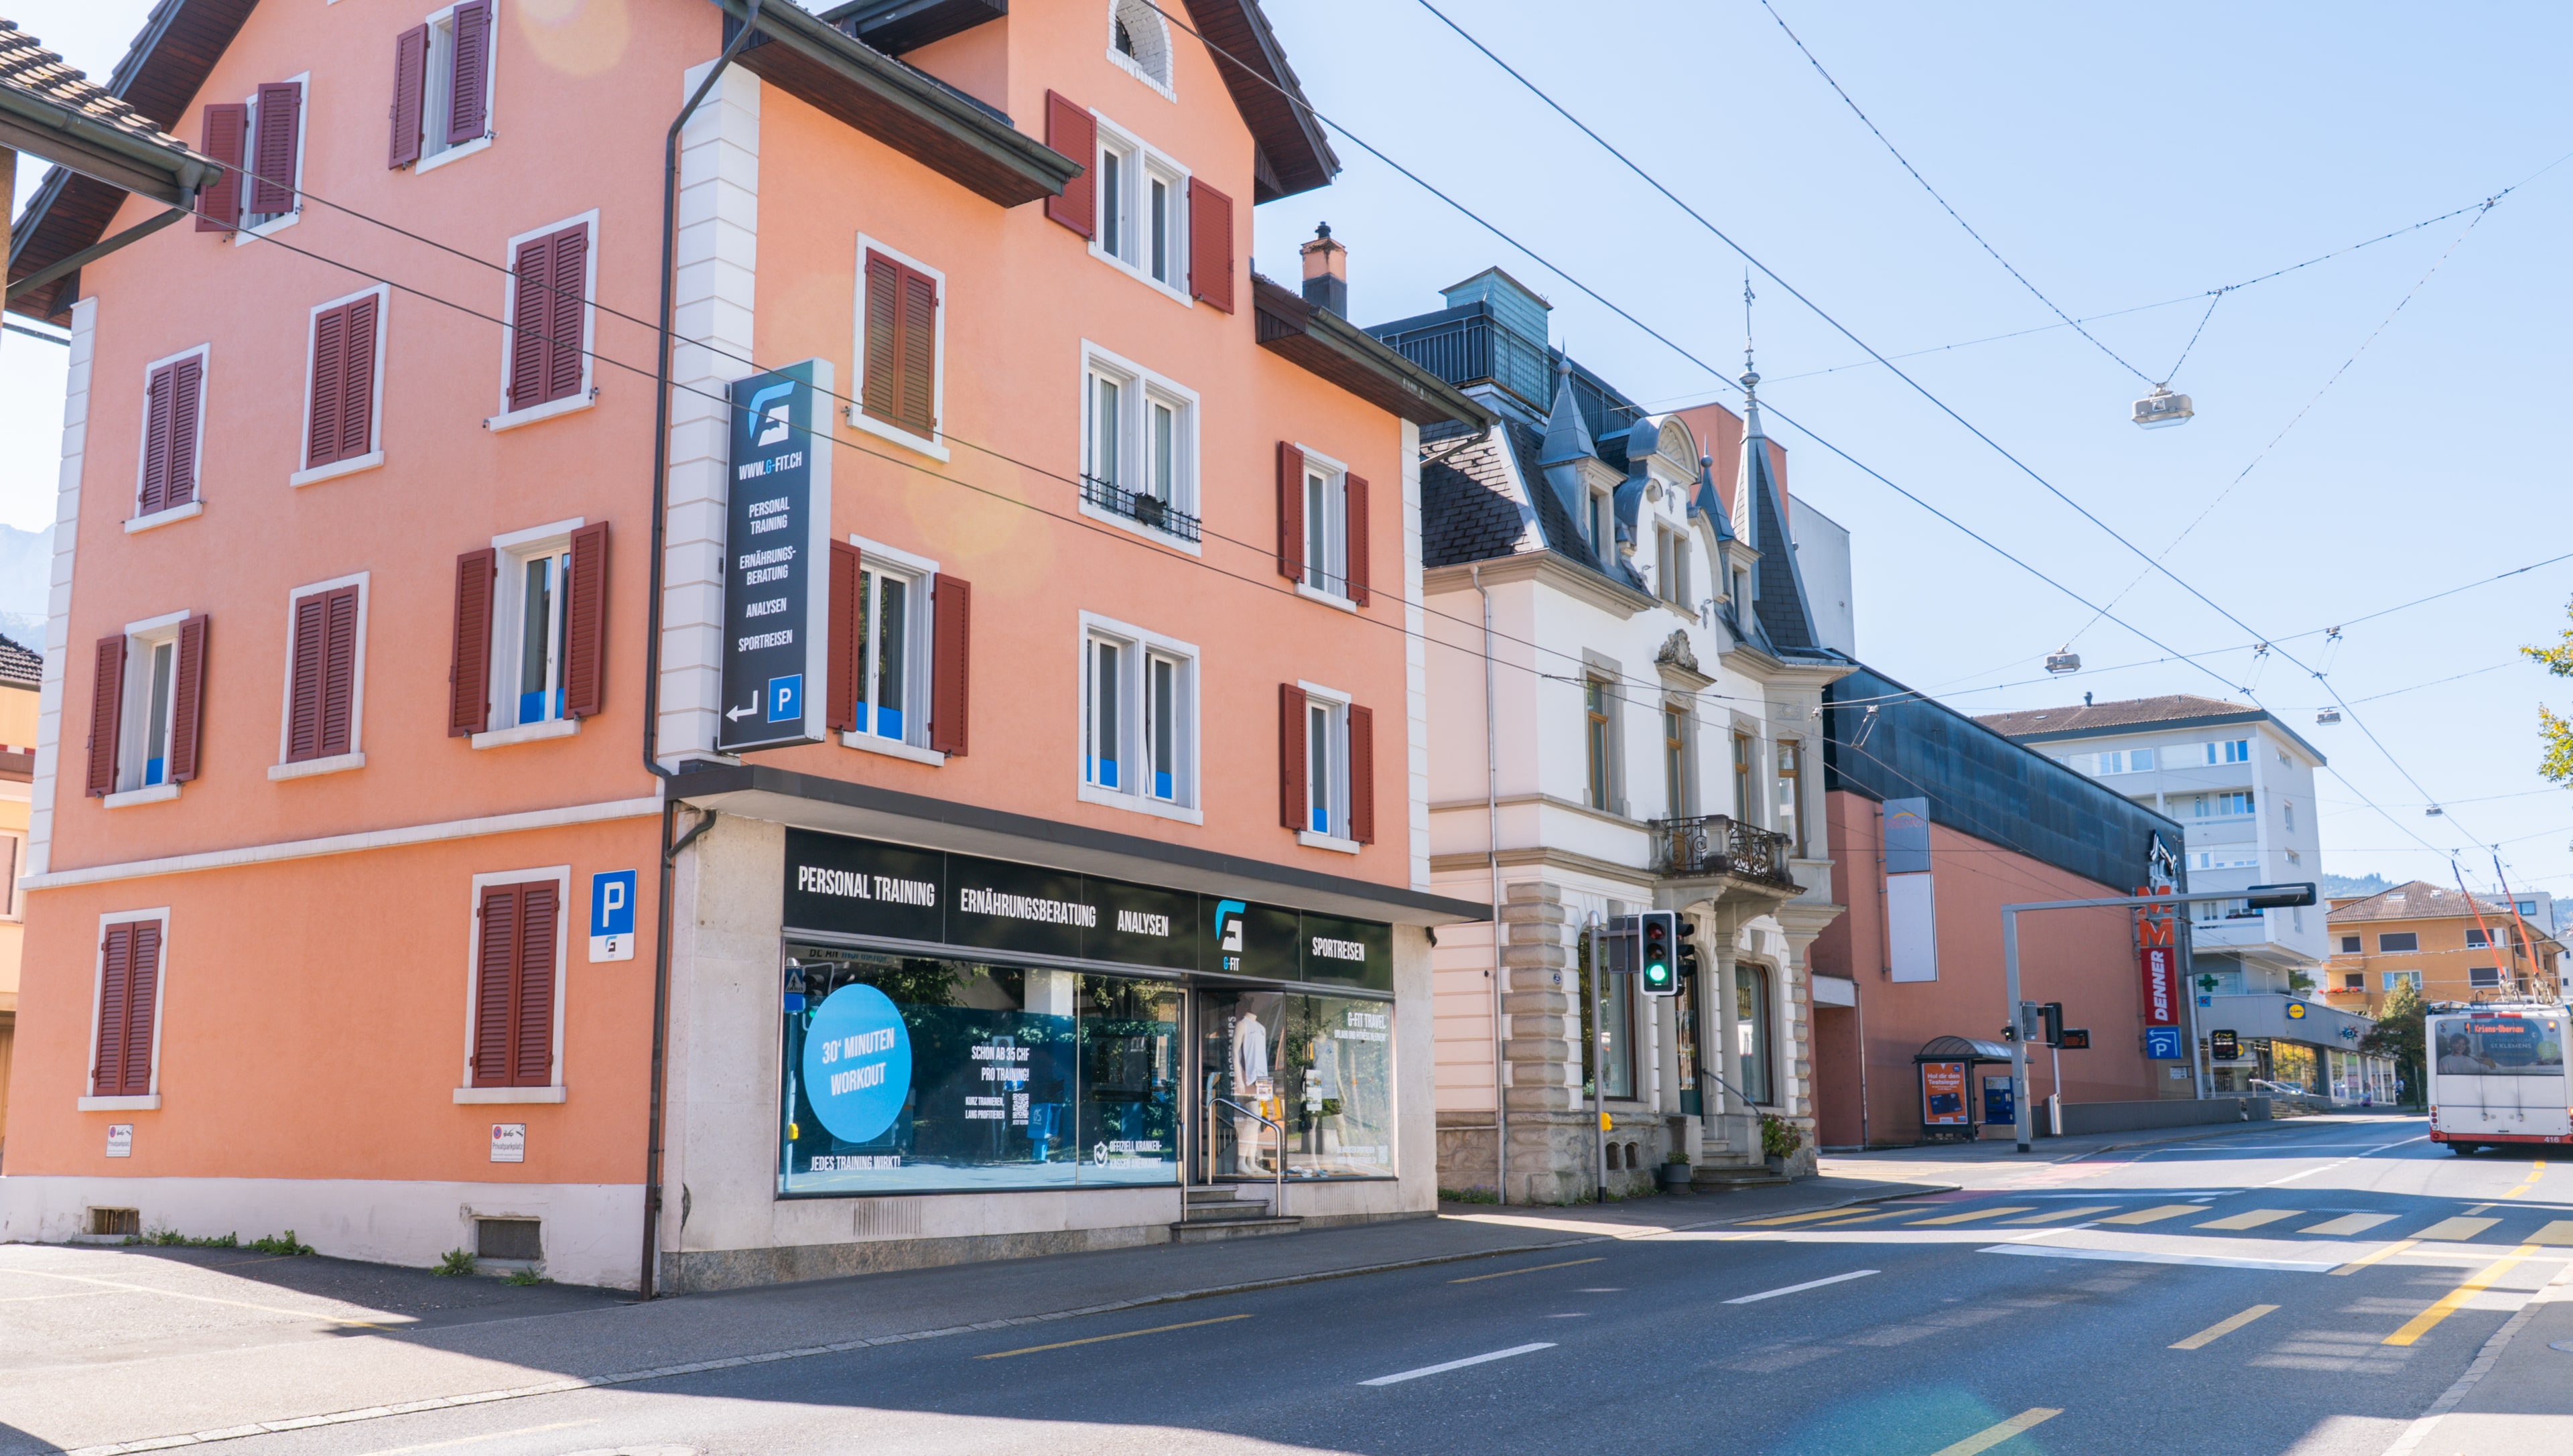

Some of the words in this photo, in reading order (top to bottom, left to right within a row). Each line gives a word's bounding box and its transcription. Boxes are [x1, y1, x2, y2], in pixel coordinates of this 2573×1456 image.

[739, 452, 802, 480] WWW.G-FIT.CH
[749, 497, 790, 519] PERSONAL
[750, 515, 788, 535] TRAINING
[740, 546, 796, 570] ERNÄHRUNGS-
[746, 565, 788, 586] BERATUNG
[746, 598, 787, 618] ANALYSEN
[738, 630, 793, 652] SPORTREISEN
[779, 687, 791, 712] P
[602, 881, 624, 927] P
[798, 866, 871, 899] PERSONAL
[874, 876, 935, 907] TRAINING
[960, 887, 1096, 928] ERNÄHRUNGSBERATUNG
[1117, 910, 1169, 937] ANALYSEN
[1312, 937, 1365, 962] SPORTREISEN
[1224, 956, 1240, 972] G-FIT
[2151, 951, 2168, 1022] DENNER
[844, 1027, 895, 1059] MINUTEN
[972, 1045, 994, 1060] SCHON
[996, 1047, 1005, 1060] AB
[1006, 1047, 1015, 1061] 35
[1016, 1047, 1030, 1061] CHF
[2156, 1044, 2167, 1057] P
[831, 1062, 886, 1096] WORKOUT
[982, 1067, 995, 1081] PRO
[996, 1067, 1029, 1081] TRAINING!
[966, 1096, 978, 1106] KURZ
[966, 1110, 978, 1119] LANG
[1110, 1140, 1134, 1152] OFFIZIELL
[810, 1156, 835, 1171] JEDES
[836, 1156, 872, 1171] TRAINING
[873, 1156, 901, 1170] WIRKT!
